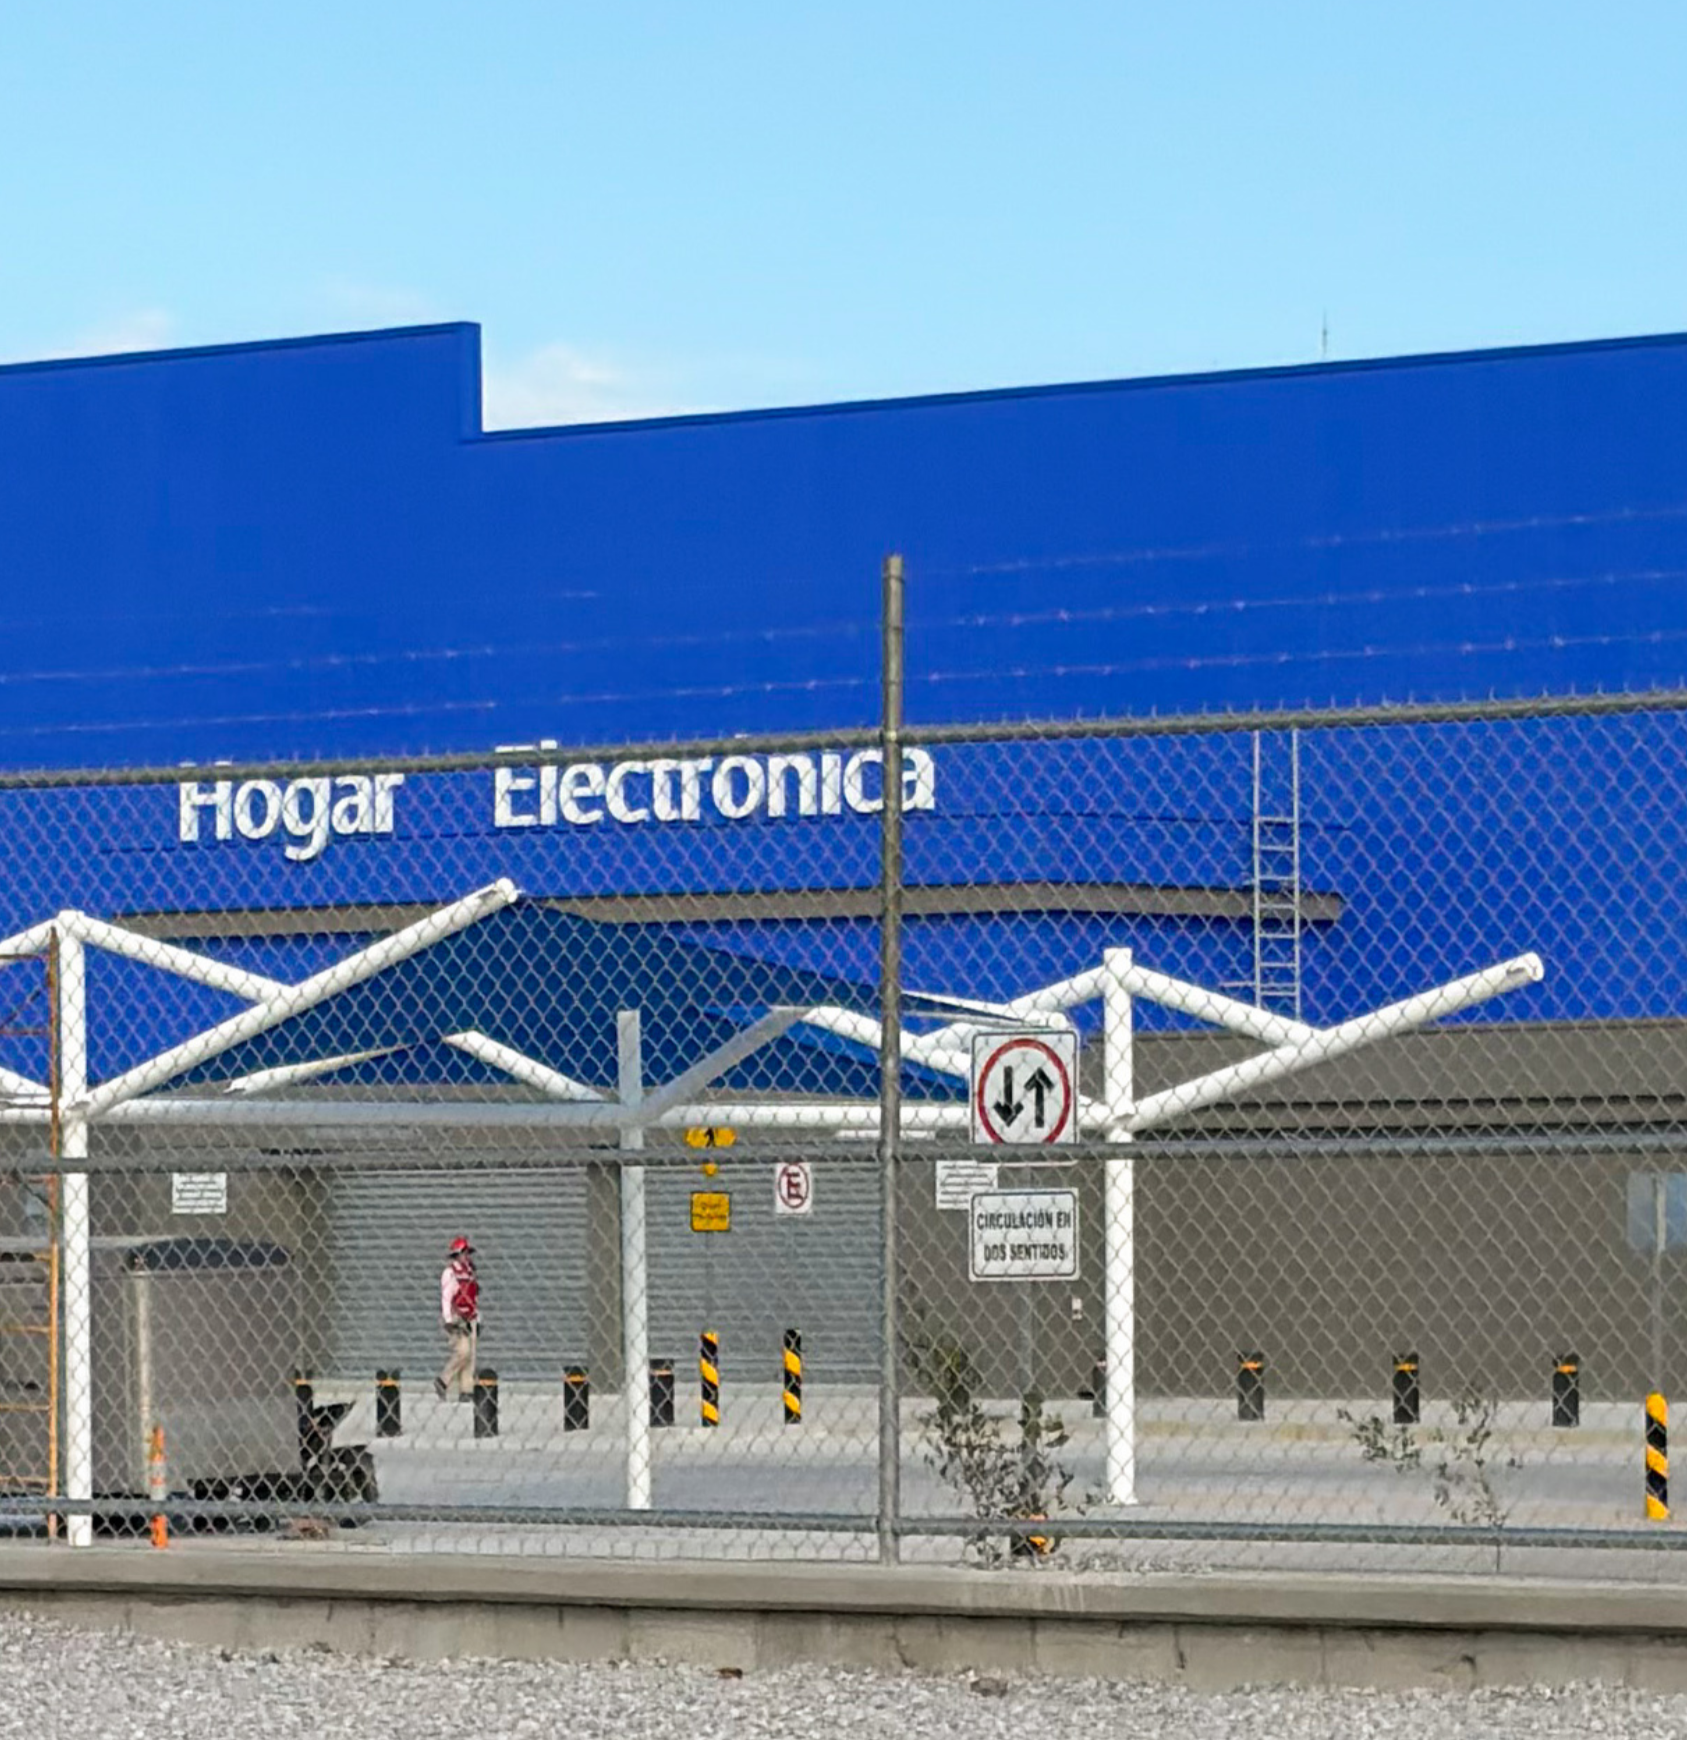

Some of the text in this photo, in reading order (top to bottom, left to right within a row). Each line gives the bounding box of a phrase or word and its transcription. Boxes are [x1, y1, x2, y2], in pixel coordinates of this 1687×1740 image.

[179, 761, 405, 861] Hogar
[976, 1208, 1072, 1230] CIRCULACIÓN EN
[983, 1244, 1007, 1261] DOS
